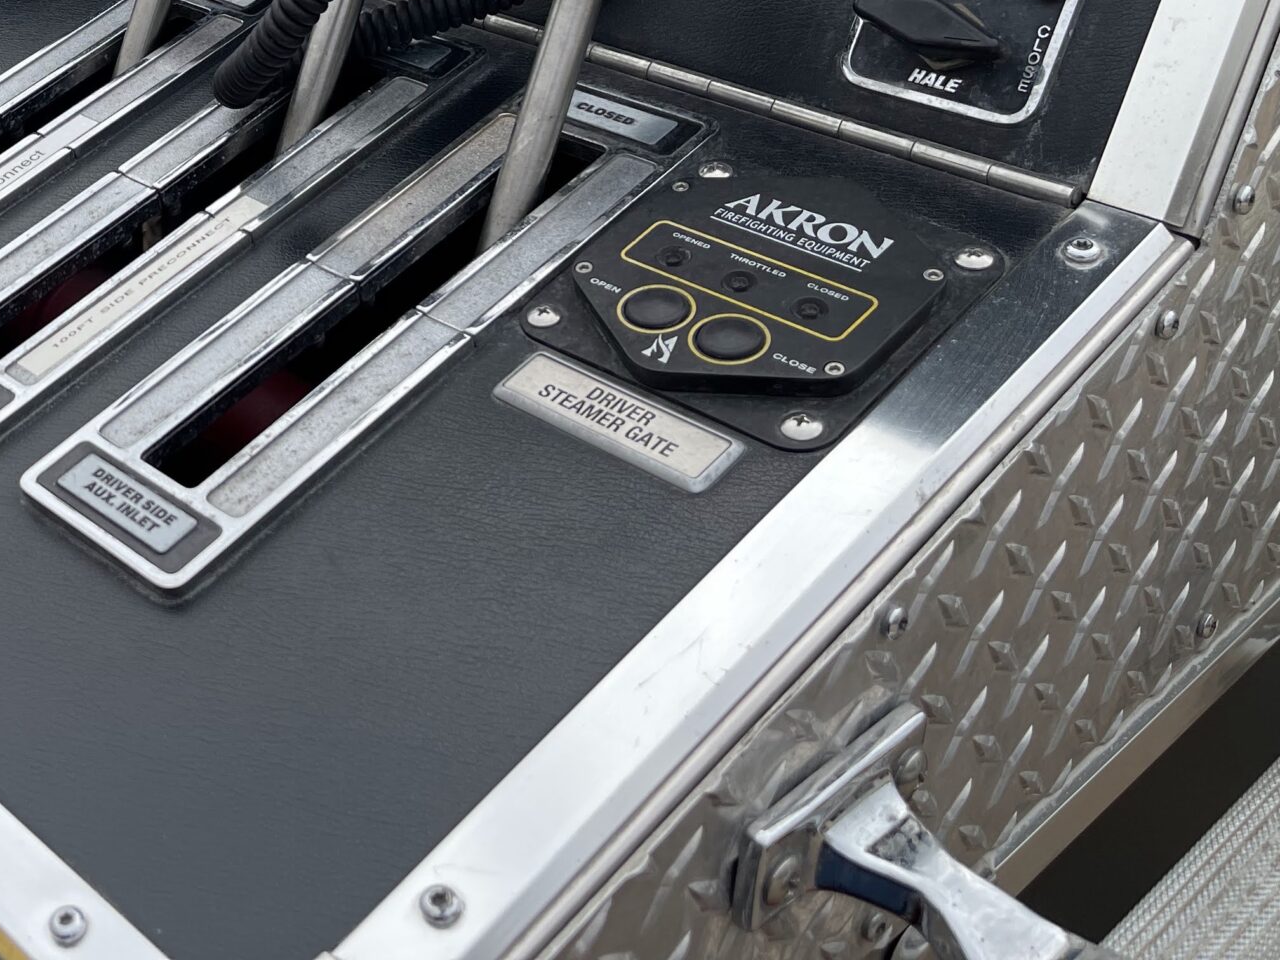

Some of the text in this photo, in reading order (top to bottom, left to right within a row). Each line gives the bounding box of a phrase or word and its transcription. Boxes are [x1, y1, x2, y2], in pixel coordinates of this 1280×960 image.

[1017, 25, 1051, 93] CLOSE
[908, 68, 963, 93] HALE
[576, 102, 637, 126] CLOSED
[672, 231, 711, 249] OPENED
[713, 208, 872, 269] FIREFIGHTING EQUIPMENT
[724, 193, 895, 259] AKRON
[52, 216, 230, 349] 100FT SIDE PRECONNECT
[589, 277, 622, 294] OPEN
[729, 252, 787, 278] THROTTLED
[807, 282, 850, 302] CLOSED
[772, 352, 817, 374] CLOSE
[538, 383, 679, 458] STEAMER GATE
[585, 386, 657, 427] DRIVER
[84, 481, 161, 532] AUX. INLET
[91, 467, 178, 526] DRIVER SIDE
